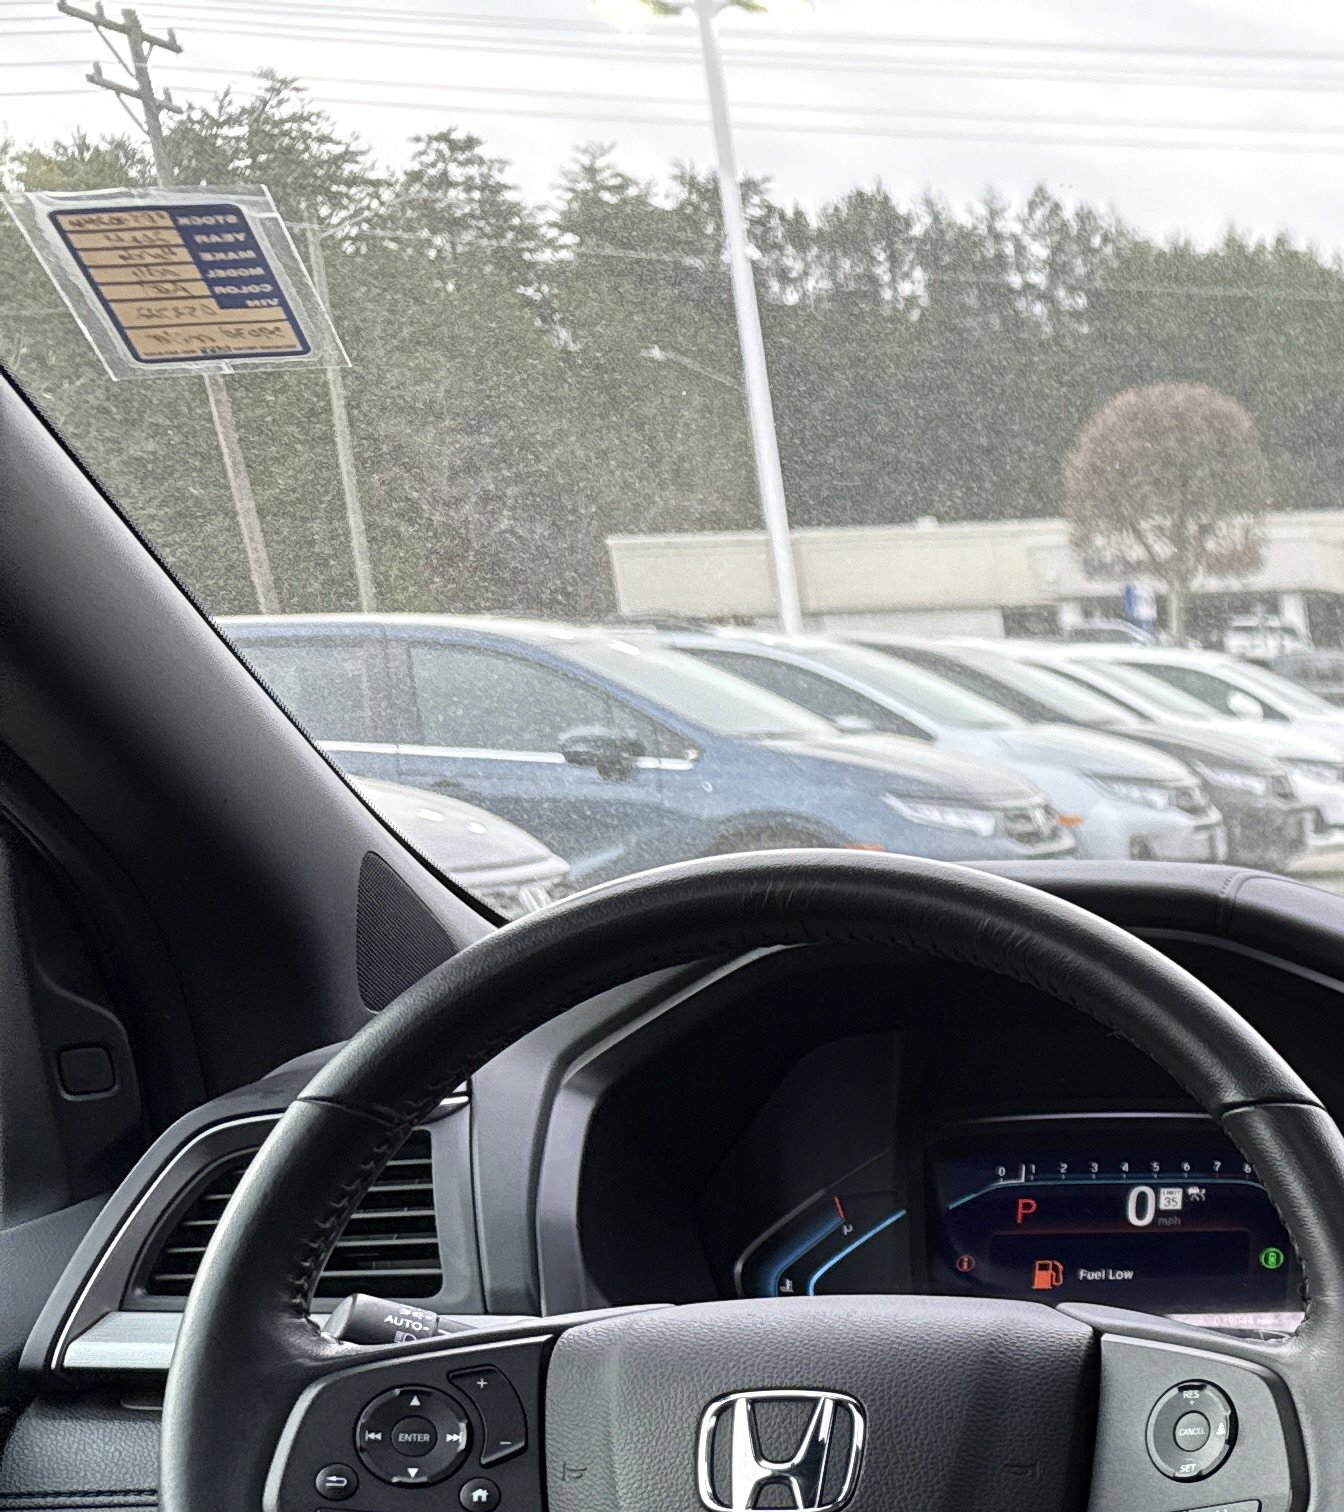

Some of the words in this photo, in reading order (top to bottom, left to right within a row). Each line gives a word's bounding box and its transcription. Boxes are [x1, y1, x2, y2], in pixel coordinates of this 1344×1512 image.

[999, 1166, 1006, 1177] 0
[1030, 1164, 1036, 1174] 1
[1060, 1163, 1068, 1174] 2
[1090, 1162, 1099, 1173] 3
[1121, 1162, 1129, 1173] 4
[1152, 1161, 1160, 1172] 5
[1182, 1161, 1191, 1172] 6
[1213, 1161, 1221, 1172] 7
[1126, 1185, 1156, 1227] 0
[1163, 1196, 1178, 1207] 35
[1016, 1198, 1037, 1224] P
[1157, 1215, 1181, 1226] mph
[1079, 1268, 1106, 1281] Fuel
[1109, 1268, 1134, 1281] Low
[1183, 1390, 1199, 1398] RES
[398, 1433, 430, 1442] ENTER
[1180, 1463, 1196, 1472] SET
